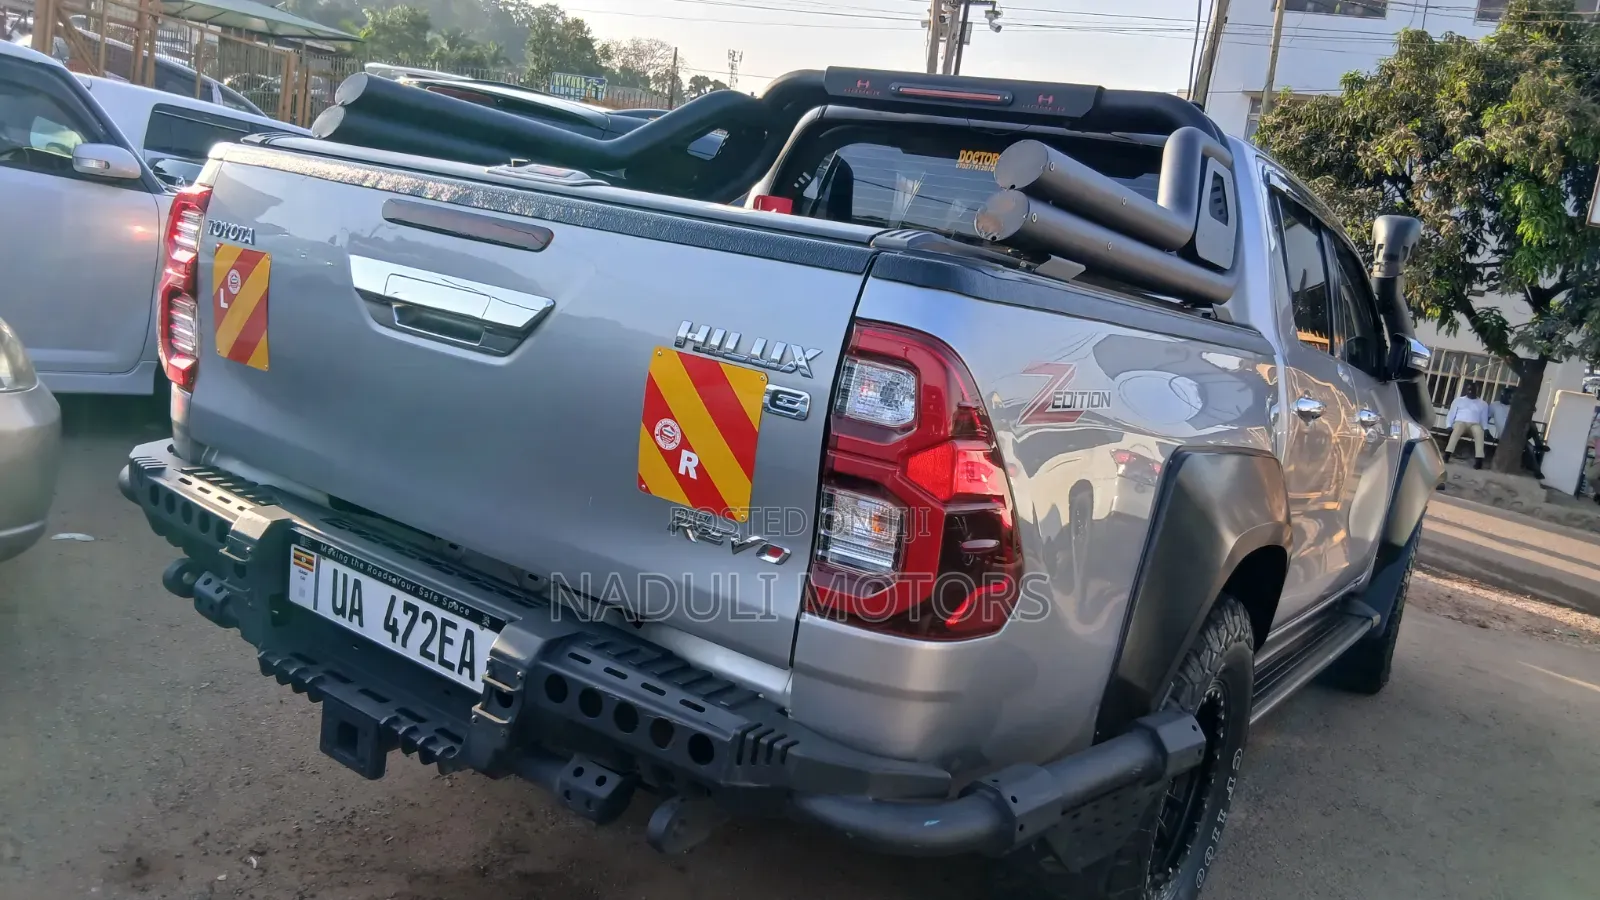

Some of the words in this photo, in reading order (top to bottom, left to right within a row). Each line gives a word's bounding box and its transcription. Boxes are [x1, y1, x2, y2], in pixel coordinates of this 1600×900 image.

[957, 149, 999, 166] DOCTOR
[208, 219, 256, 246] TOYOTA
[220, 288, 229, 309] L
[674, 320, 823, 379] HILUX
[763, 384, 811, 421] G
[1017, 361, 1077, 426] Z
[1052, 391, 1111, 409] EDITION
[678, 449, 700, 480] R
[320, 544, 348, 564] Making
[350, 558, 365, 570] the
[366, 565, 393, 582] Roads
[396, 577, 416, 592] Your
[418, 587, 439, 602] Safe
[441, 597, 470, 616] Space
[331, 568, 364, 628] UA
[383, 594, 476, 682] 472EA
